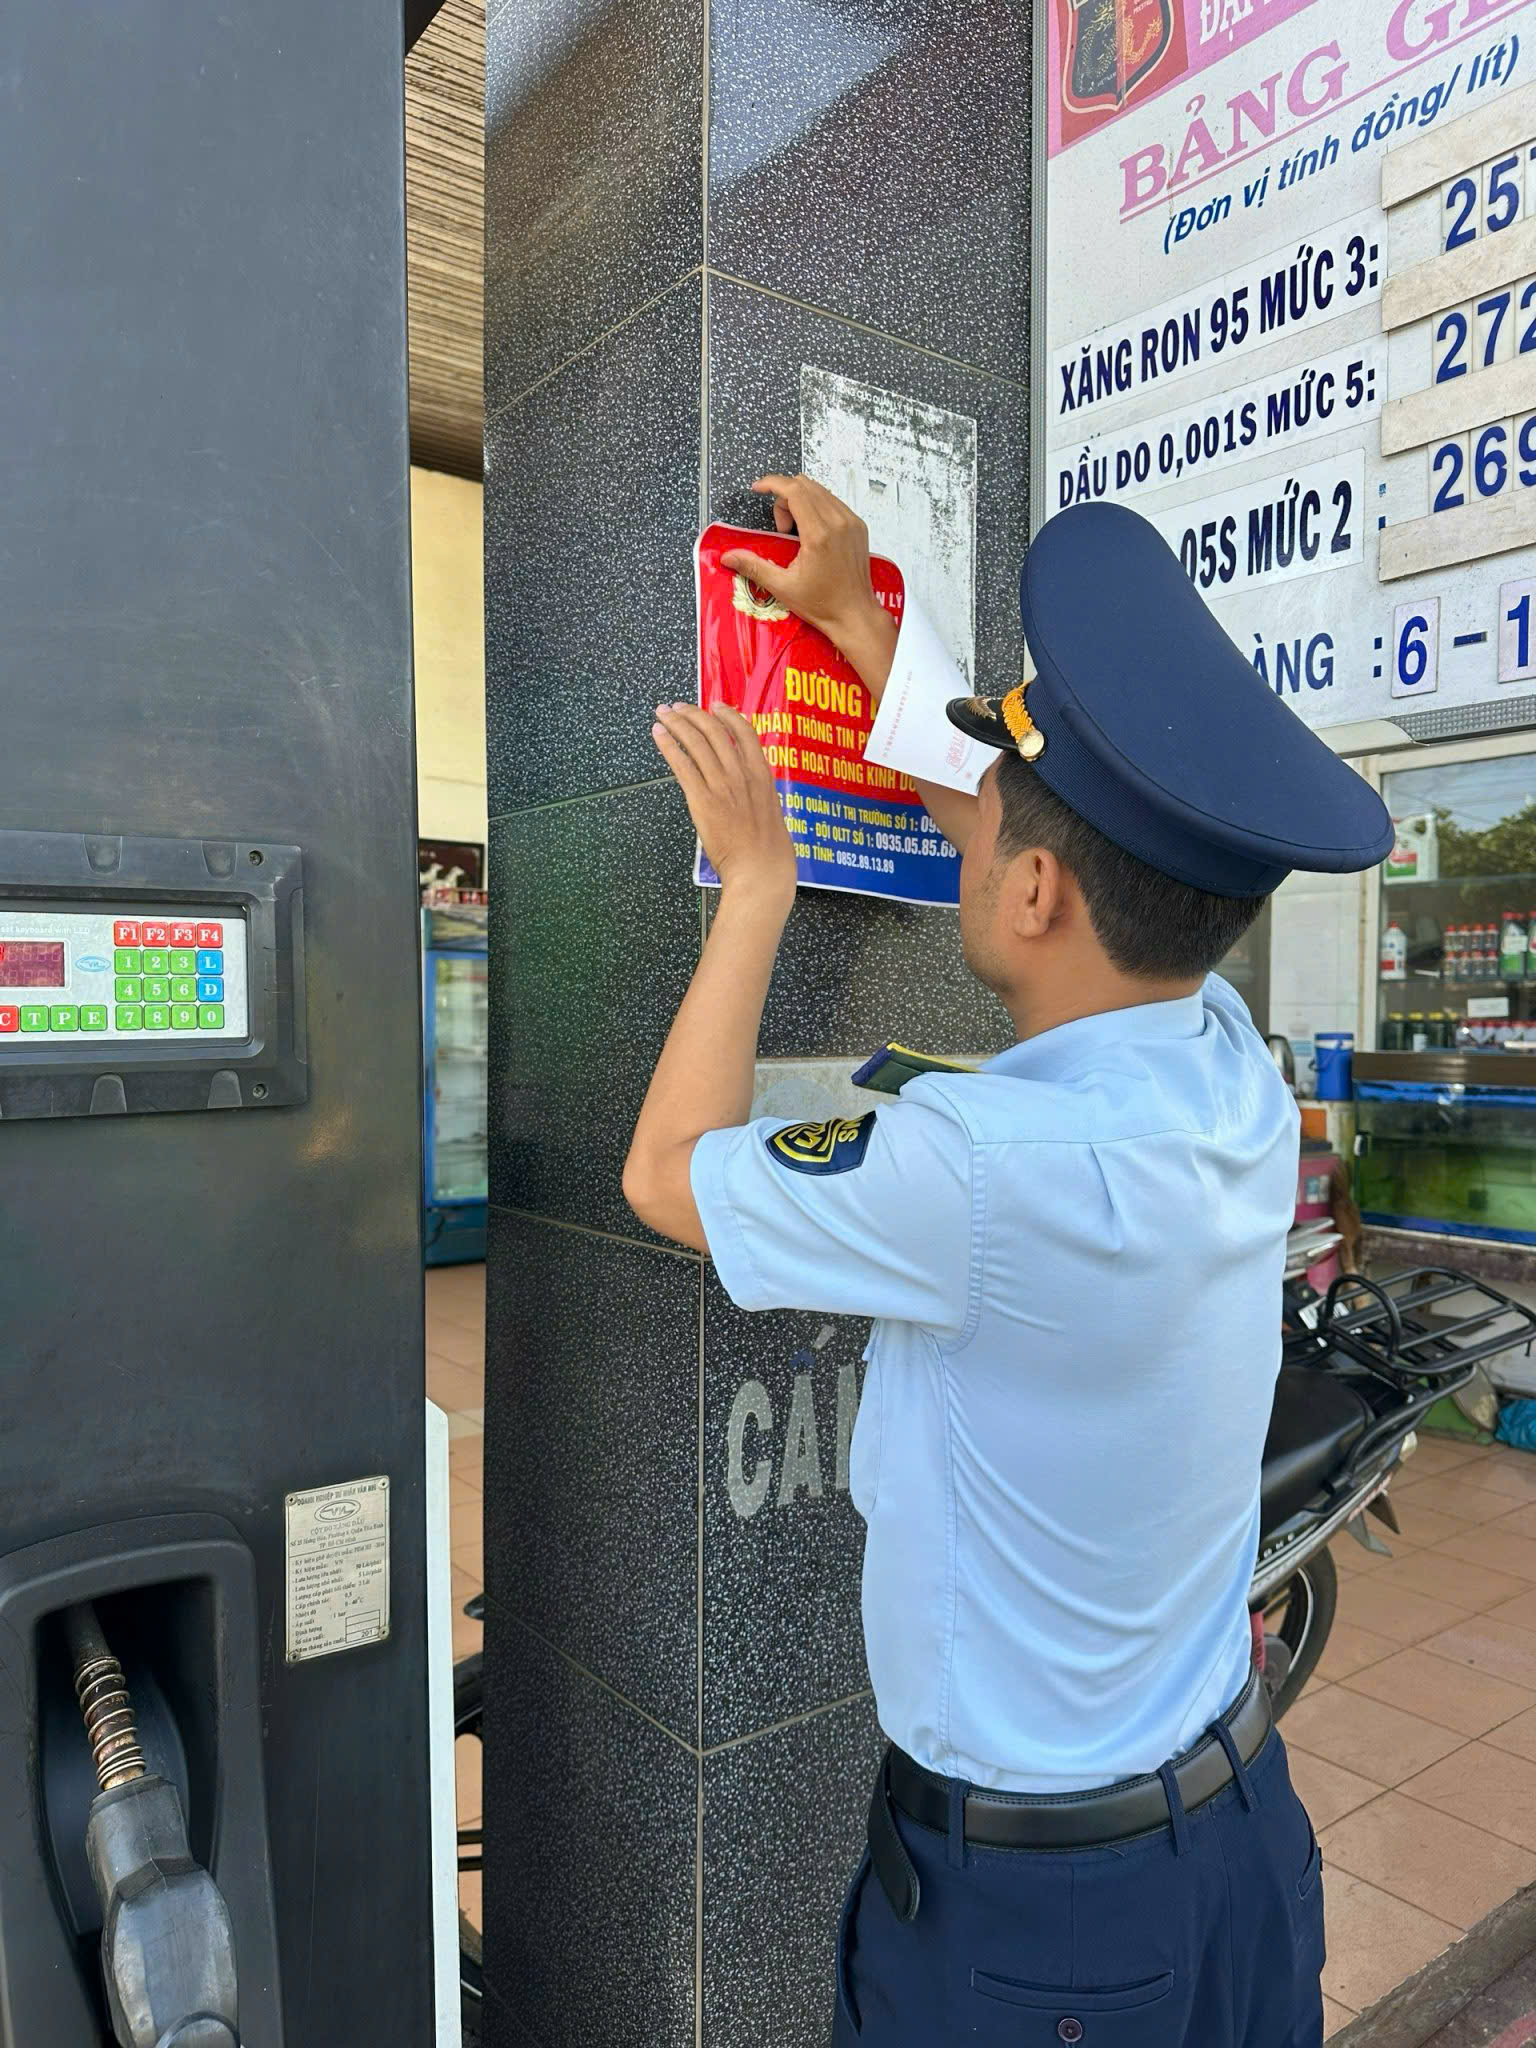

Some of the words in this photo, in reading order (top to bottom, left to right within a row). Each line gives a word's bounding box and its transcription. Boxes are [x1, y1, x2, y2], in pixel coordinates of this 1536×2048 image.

[1120, 40, 1350, 214] BẢNG
[1164, 194, 1231, 254] (Đơn
[1244, 167, 1268, 208] vị
[1279, 138, 1339, 191] tính
[1351, 64, 1462, 153] đồng/
[1467, 34, 1519, 94] lít)
[1445, 145, 1536, 250] 25
[1061, 344, 1132, 414] XĂNG
[1141, 309, 1200, 383] RON
[1210, 287, 1248, 353] 95
[1260, 244, 1334, 335] MỨC
[1345, 235, 1379, 297] 3:
[1060, 445, 1108, 508] DẦU
[1116, 434, 1150, 490] DO
[1159, 403, 1256, 478] 0,001S
[1267, 367, 1335, 438] MỨC
[1346, 360, 1375, 408] 5:
[1248, 479, 1321, 576] MỨC
[1331, 480, 1352, 553] 2
[1398, 615, 1428, 685] 6
[1507, 595, 1530, 667] 1
[786, 667, 862, 718] ĐƯỜNG
[752, 708, 792, 737] NHẬN
[796, 714, 833, 744] THÔNG
[836, 725, 854, 750] TIN
[801, 750, 830, 780] HOẠT
[833, 756, 863, 784] ĐỘNG
[867, 766, 896, 789] KINH
[786, 792, 804, 813] ĐỘI
[806, 795, 830, 815] QUẢN
[895, 812, 907, 830] SỐ
[909, 818, 918, 832] 1:
[816, 821, 831, 840] ĐỘI
[832, 826, 850, 843] QLTT
[852, 827, 864, 845] SỐ
[866, 833, 874, 848] 1:
[836, 850, 894, 874] 0852.89.13.89
[118, 926, 138, 941] F1
[146, 927, 165, 941] F2
[173, 928, 193, 942] F3
[200, 929, 220, 942] F4
[124, 956, 133, 968] 1
[151, 956, 161, 969] 2
[179, 957, 189, 969] 3
[205, 957, 217, 970] L
[123, 984, 134, 996] 4
[152, 984, 162, 996] 5
[179, 984, 189, 996] 6
[28, 1013, 41, 1026] T
[58, 1013, 71, 1026] P
[88, 1012, 101, 1025] E
[125, 1012, 135, 1024] 7
[152, 1012, 162, 1024] 8
[180, 1012, 190, 1024] 9
[207, 1011, 217, 1023] 0
